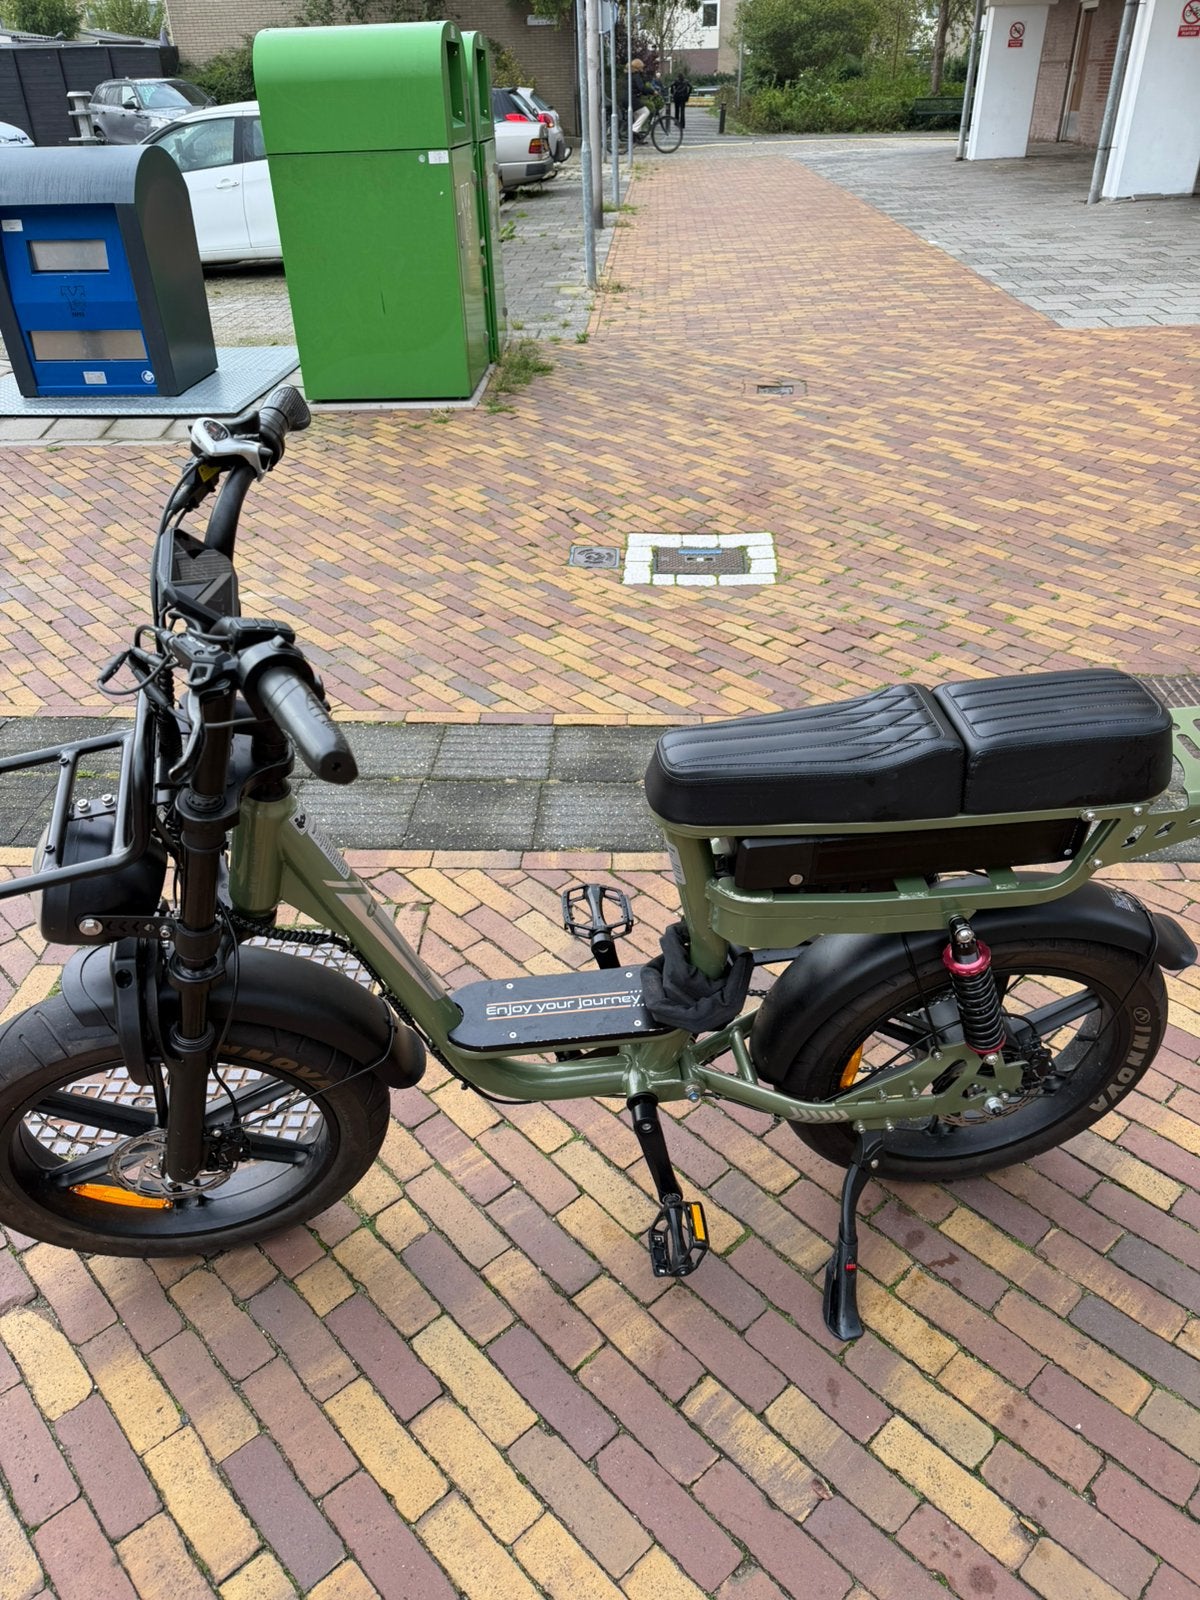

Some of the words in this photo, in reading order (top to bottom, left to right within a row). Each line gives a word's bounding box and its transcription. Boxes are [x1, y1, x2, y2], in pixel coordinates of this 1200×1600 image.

[486, 1003, 535, 1016] Enjoy
[536, 1000, 575, 1013] your
[577, 994, 641, 1009] journey
[1089, 1025, 1152, 1112] INNOVA
